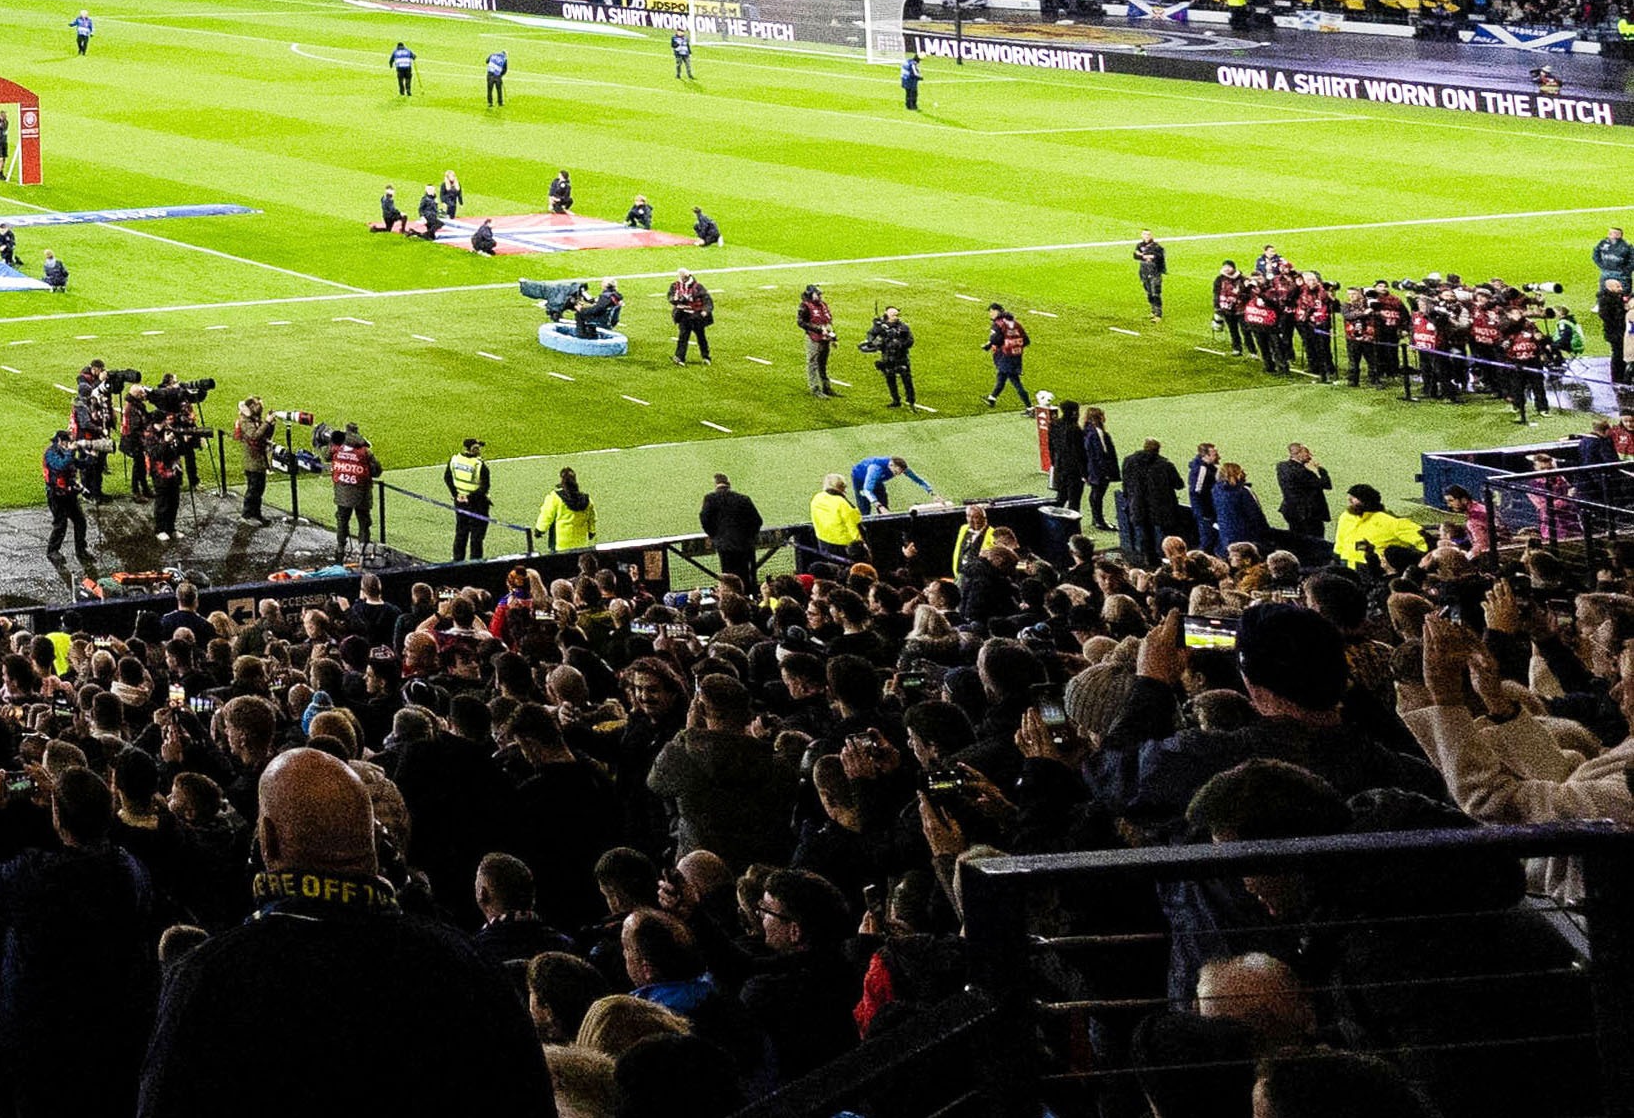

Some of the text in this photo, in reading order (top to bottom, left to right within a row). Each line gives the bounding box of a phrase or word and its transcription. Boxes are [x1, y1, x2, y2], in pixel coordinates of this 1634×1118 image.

[563, 3, 594, 22] OWN
[596, 6, 607, 23] A
[609, 6, 648, 27] SHIRT
[695, 14, 717, 32] ON
[751, 20, 795, 42] PITCH
[924, 36, 1093, 72] MATCHWORNSHIRT
[1217, 65, 1614, 126] OWN A SHIRT WORN ON THE PITCH
[334, 462, 364, 474] PHOTO
[339, 473, 357, 484] 426
[302, 874, 357, 903] OFF
